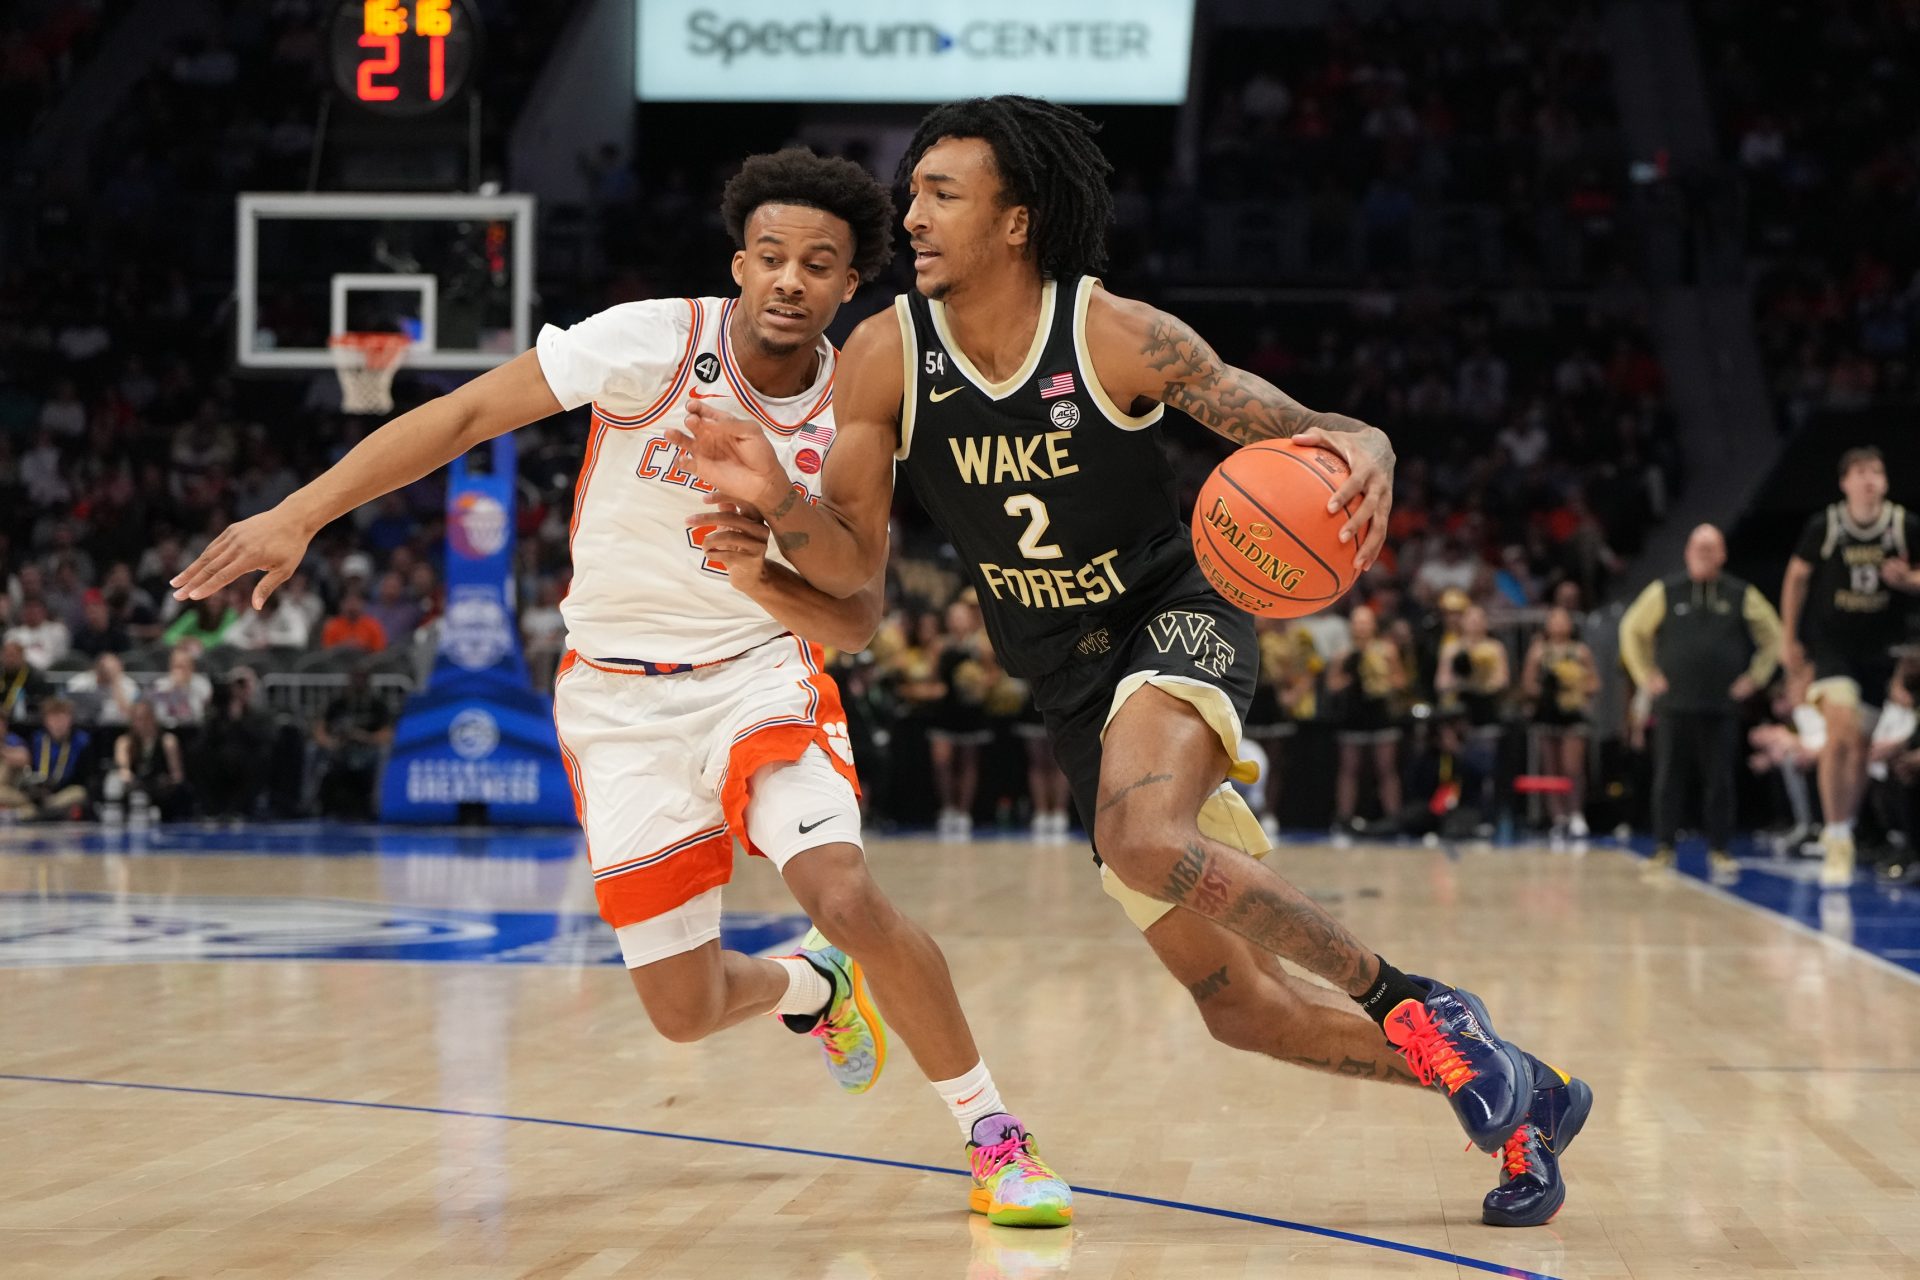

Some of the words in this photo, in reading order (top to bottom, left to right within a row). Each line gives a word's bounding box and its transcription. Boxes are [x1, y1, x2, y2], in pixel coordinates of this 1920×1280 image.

[357, 34, 445, 101] 21
[686, 9, 941, 68] Spectrum
[959, 19, 1151, 60] CENTER
[695, 356, 719, 381] 41
[925, 350, 945, 375] 54
[948, 430, 1080, 485] WAKE
[1003, 493, 1064, 560] 2
[1205, 496, 1306, 593] SPALDING
[979, 549, 1127, 609] FOREST
[1144, 610, 1236, 679] WF
